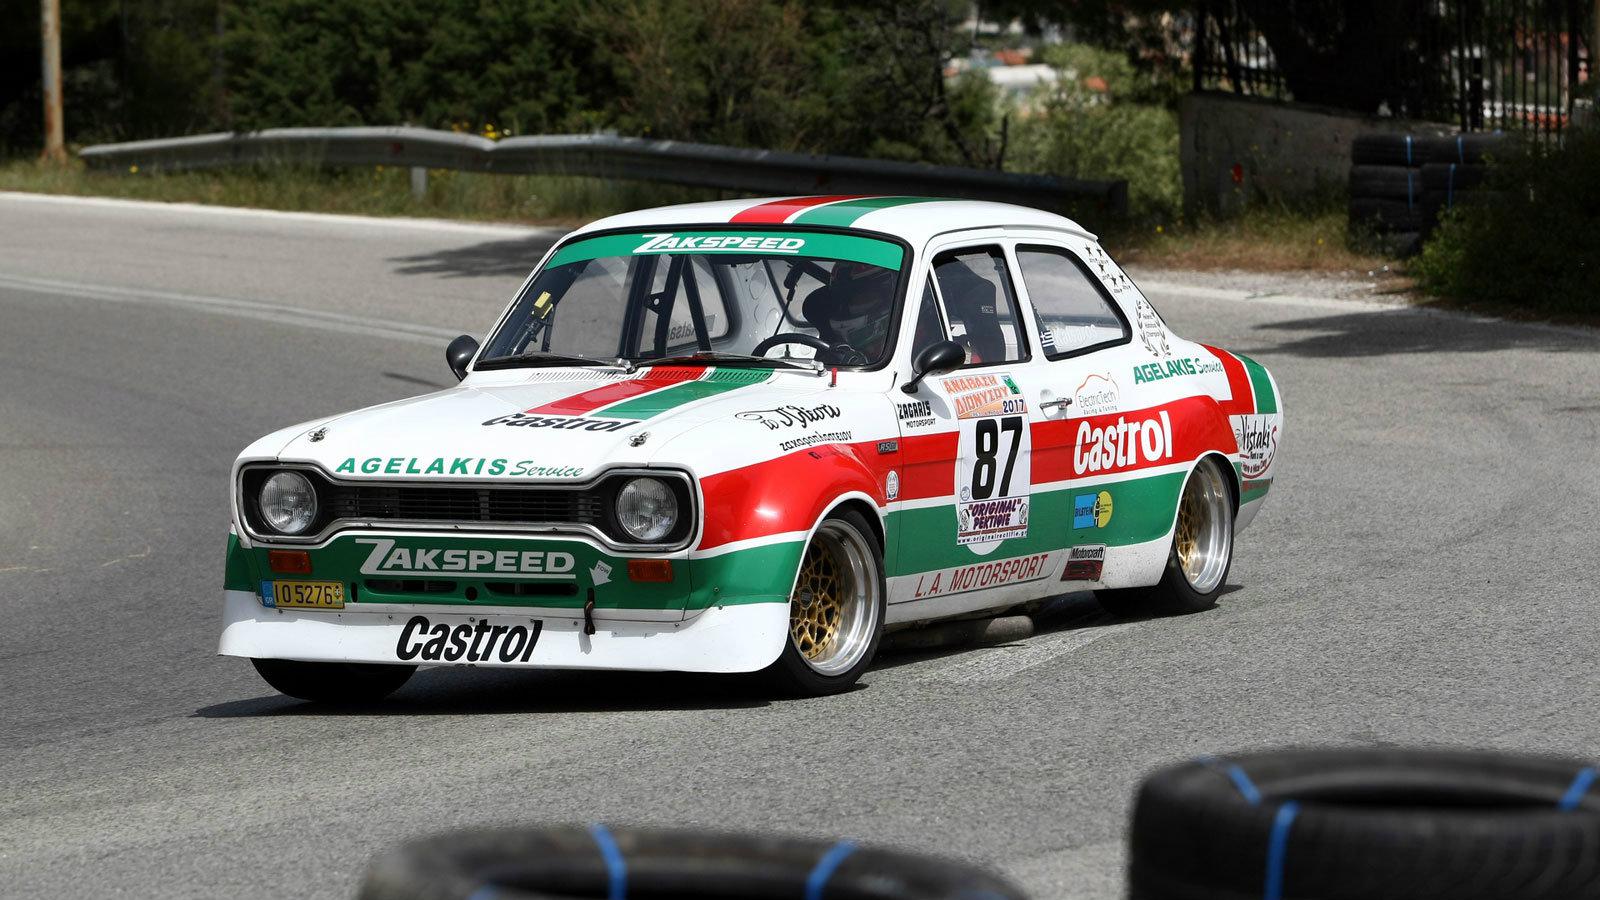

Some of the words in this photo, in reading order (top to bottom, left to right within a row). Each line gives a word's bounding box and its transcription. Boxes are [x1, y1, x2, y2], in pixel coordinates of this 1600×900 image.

[633, 234, 805, 253] ZAKSPEED
[1133, 358, 1197, 385] AGELAKIS
[1195, 358, 1223, 374] Service
[897, 400, 931, 420] ZAGARIS
[1002, 398, 1025, 413] 2017
[482, 413, 641, 432] Castrol
[906, 418, 936, 428] MOTORSPORT
[1073, 410, 1173, 475] Castrol
[335, 457, 508, 475] AGELAKIS
[509, 460, 583, 478] Service
[971, 416, 1023, 500] 87
[968, 498, 1022, 517] "ORIGINAL"
[958, 530, 1027, 544] www.originalrectifie.gr
[355, 538, 576, 579] ZAKSPEED
[1071, 546, 1104, 560] Motorcraft
[597, 563, 609, 574] TOW
[915, 572, 942, 597] L.A.
[949, 554, 1048, 592] MOTORSPORT
[295, 585, 333, 605] 5276
[396, 615, 543, 663] Castrol
